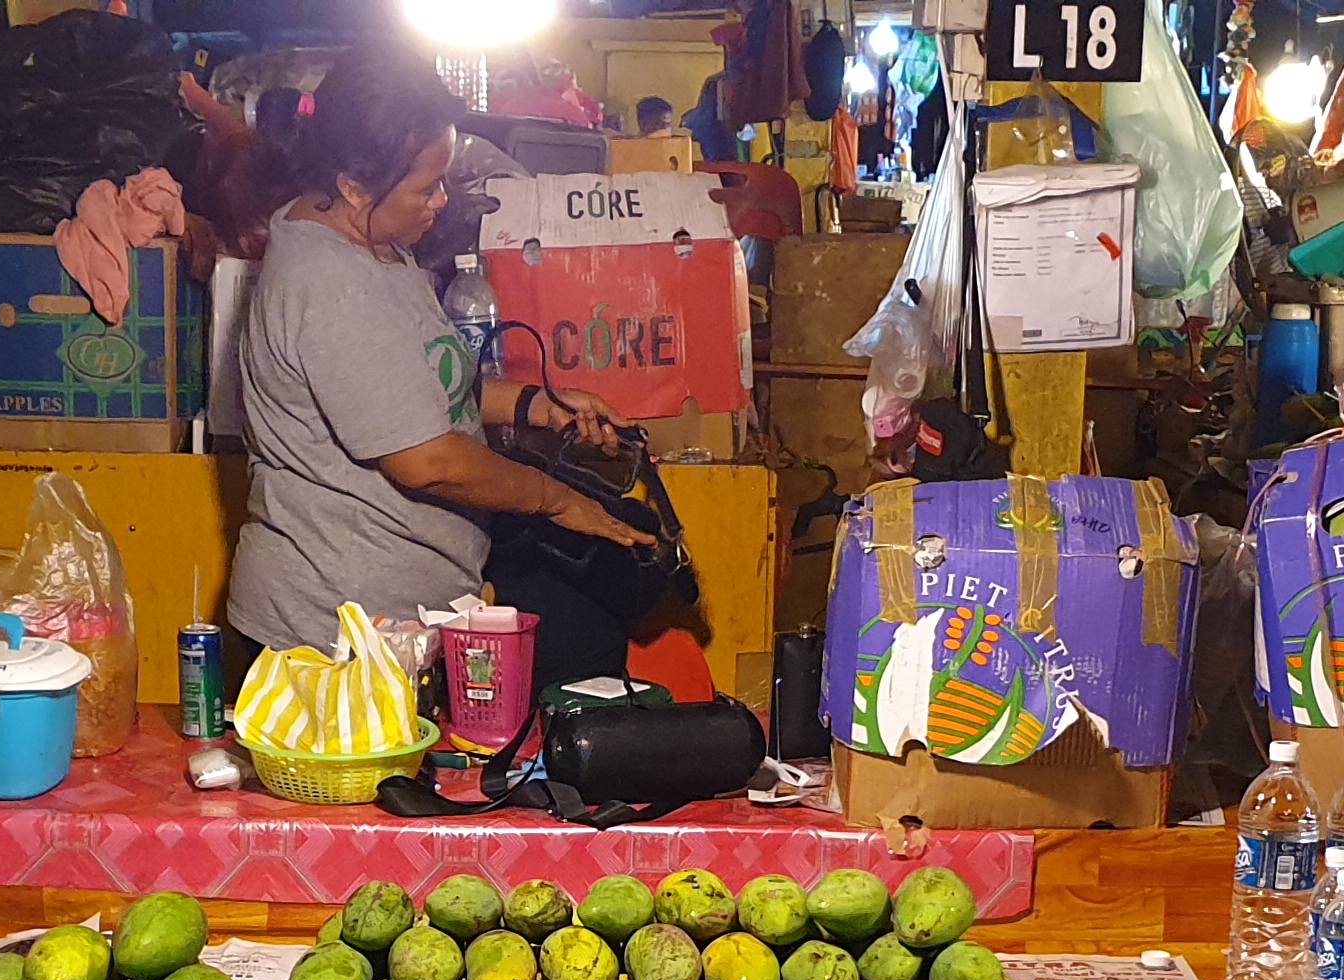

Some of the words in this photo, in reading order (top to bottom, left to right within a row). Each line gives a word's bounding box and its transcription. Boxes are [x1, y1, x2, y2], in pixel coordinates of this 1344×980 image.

[1013, 4, 1044, 69] L
[1060, 4, 1117, 70] 18
[566, 182, 643, 220] CÓRE
[552, 302, 676, 371] CÓRE
[920, 571, 1008, 608] PIET
